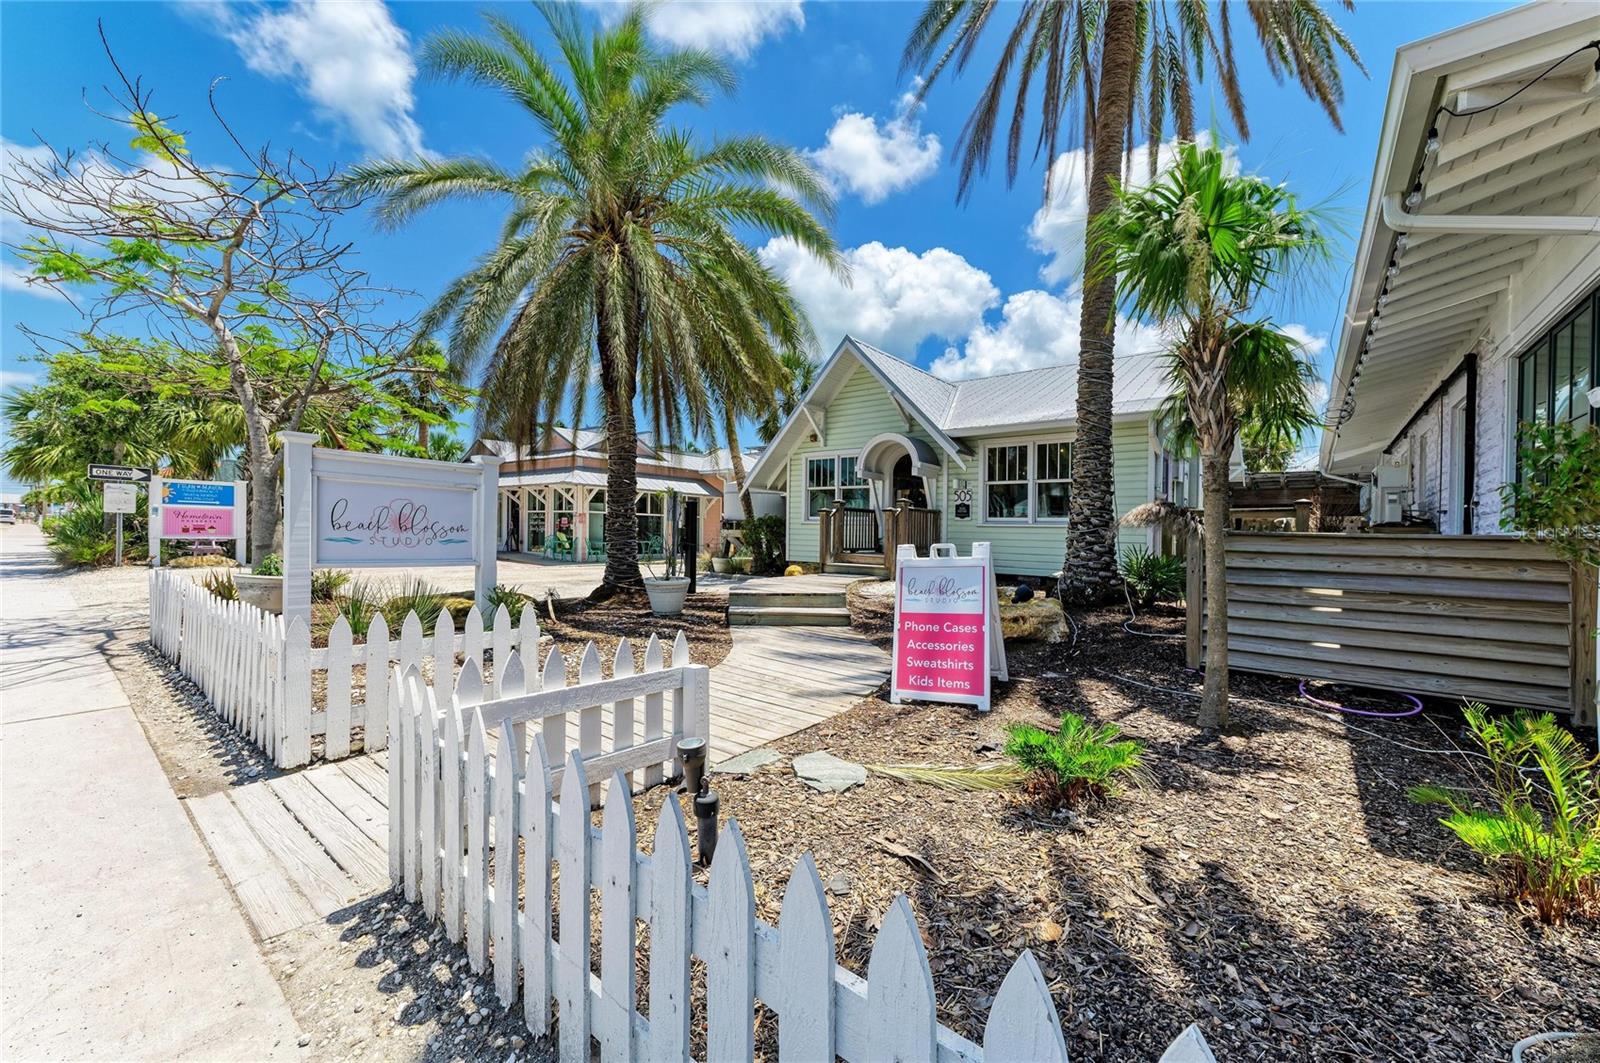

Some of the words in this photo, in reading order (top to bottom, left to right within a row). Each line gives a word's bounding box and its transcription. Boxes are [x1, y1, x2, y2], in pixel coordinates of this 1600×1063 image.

[954, 490, 972, 502] 505
[173, 510, 222, 520] Hometown
[331, 498, 389, 534] beach
[399, 502, 470, 540] blossom
[369, 536, 433, 546] STUDIO
[907, 577, 935, 596] beach
[939, 576, 979, 600] blossom
[904, 621, 940, 632] Phone
[943, 622, 978, 633] Cases
[906, 639, 975, 652] Accessories
[906, 656, 974, 671] Sweatshirts
[908, 675, 934, 687] Kids
[937, 677, 971, 689] Items
